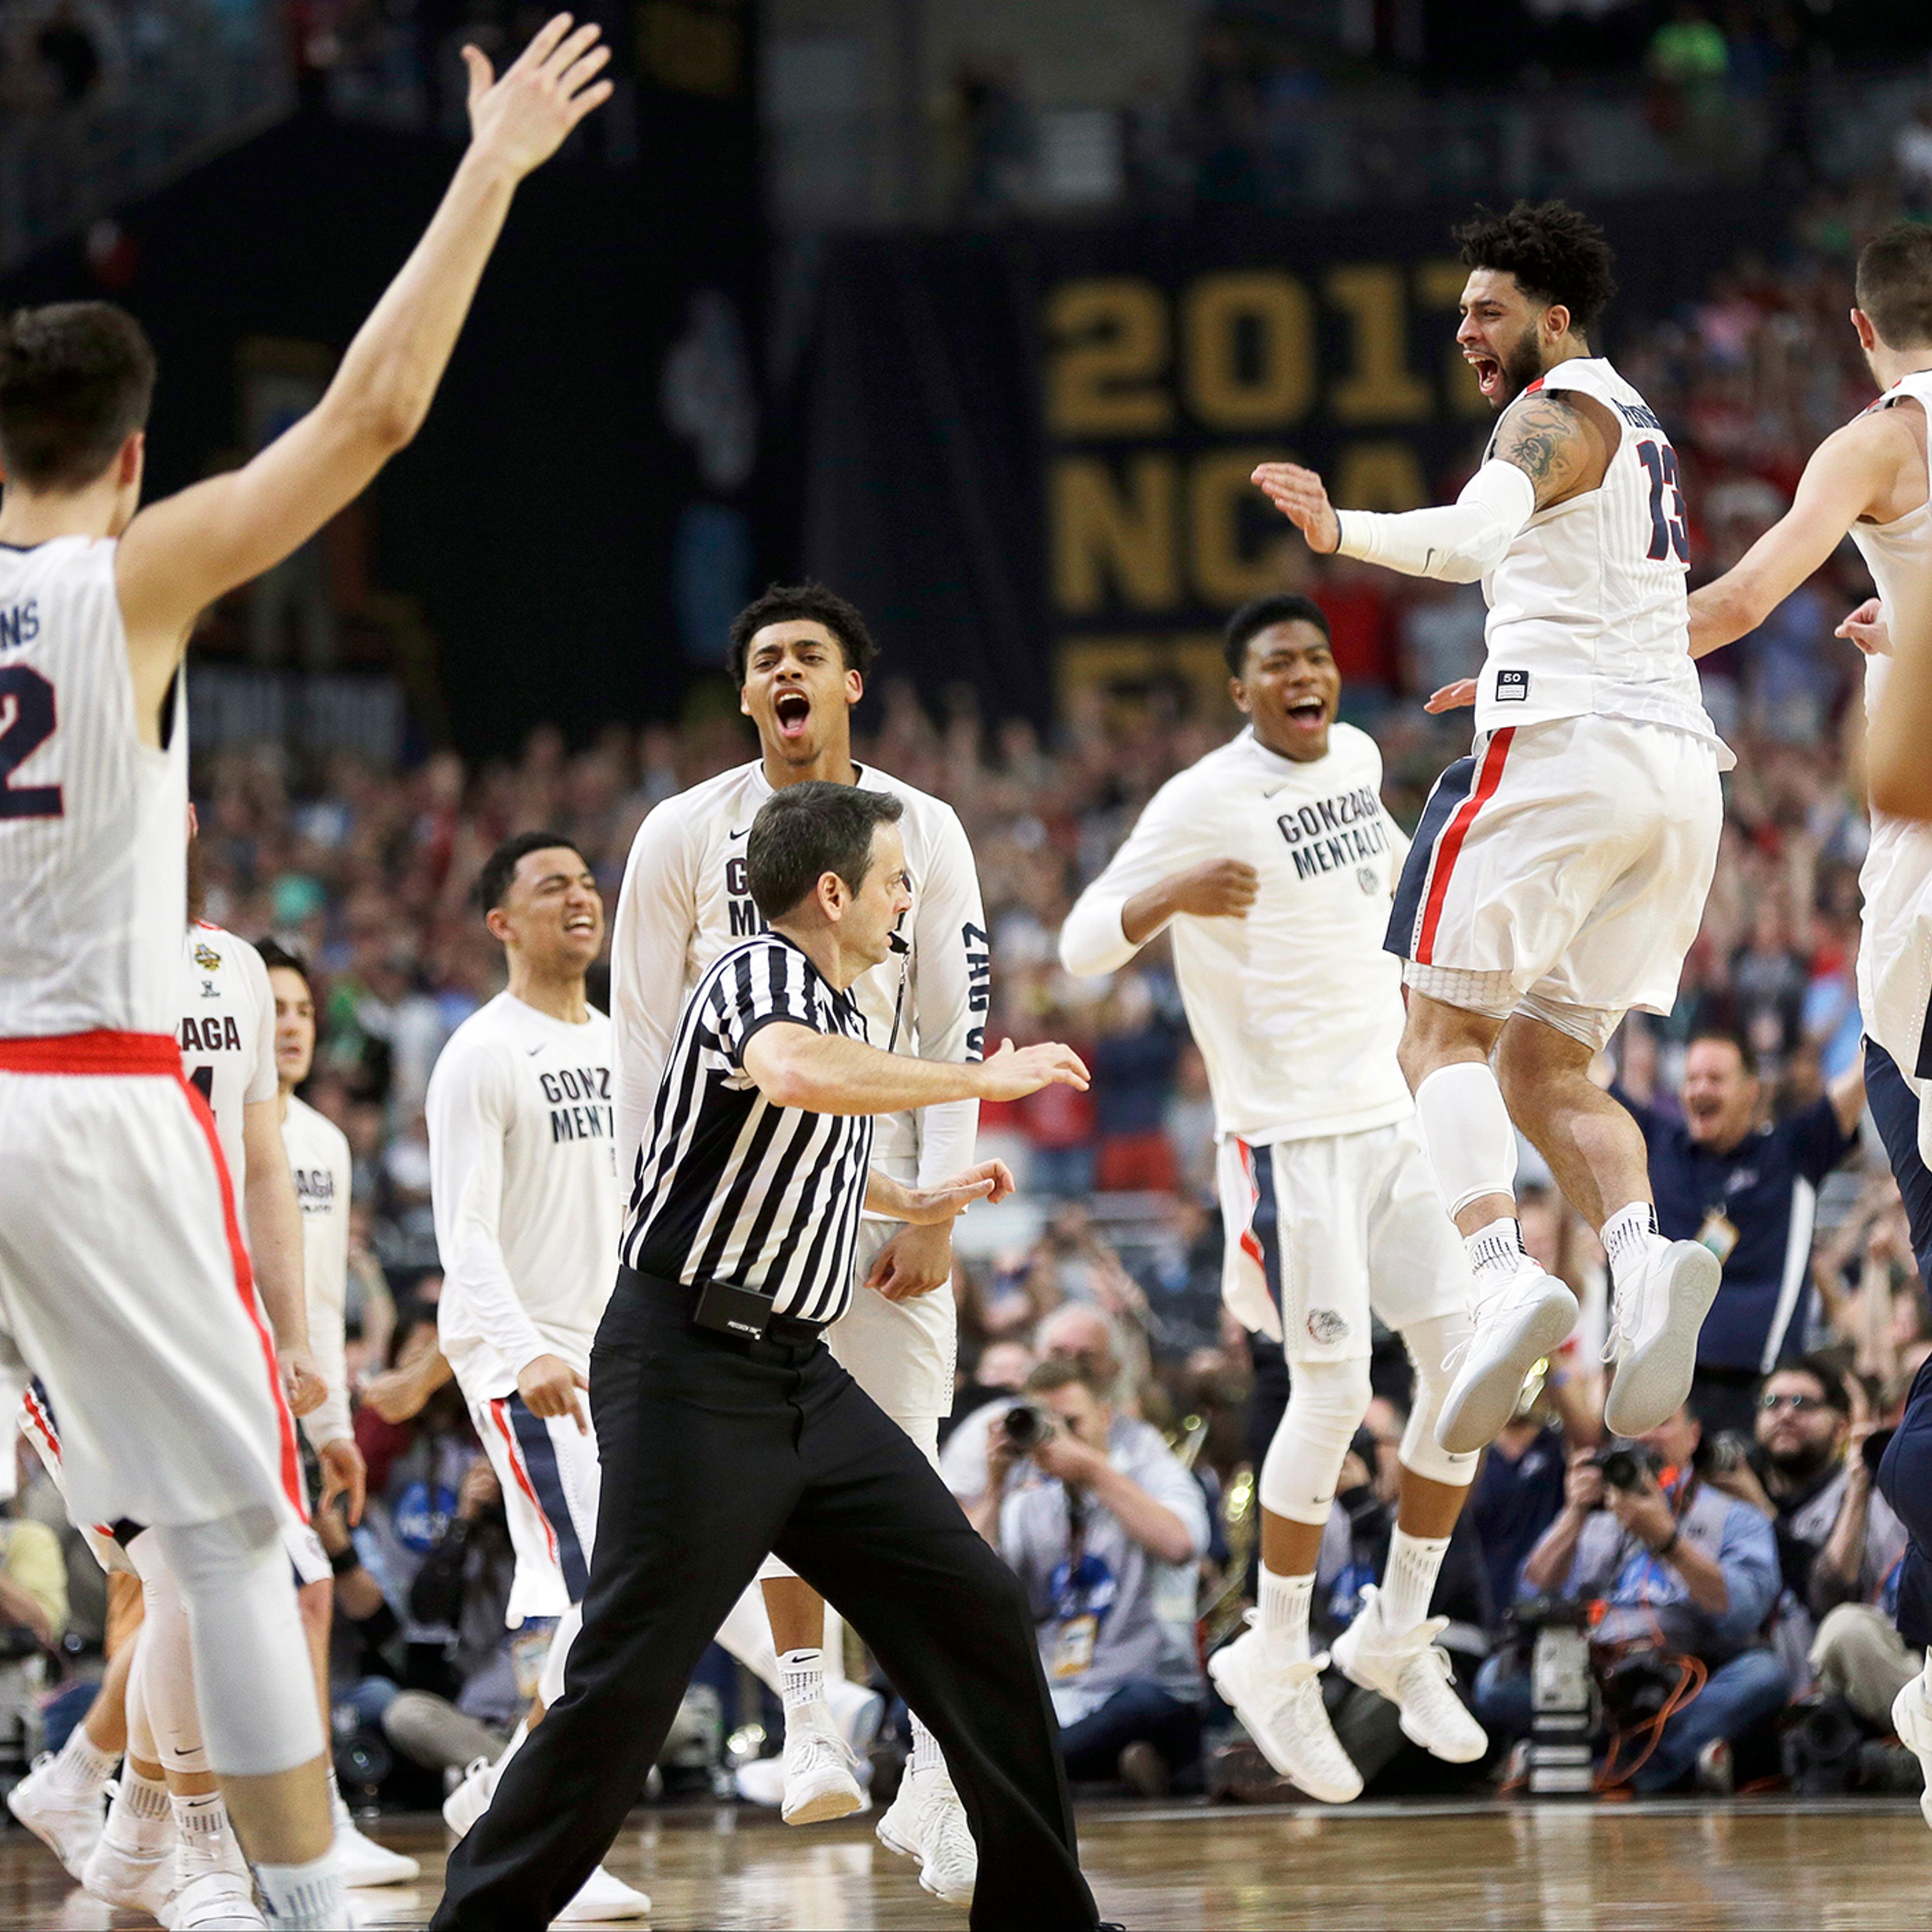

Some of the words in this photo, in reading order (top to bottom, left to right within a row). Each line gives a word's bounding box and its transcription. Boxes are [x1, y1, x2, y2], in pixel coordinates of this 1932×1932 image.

[1636, 439, 1691, 564] 13
[1503, 673, 1521, 682] 50
[175, 1016, 241, 1051] AGA
